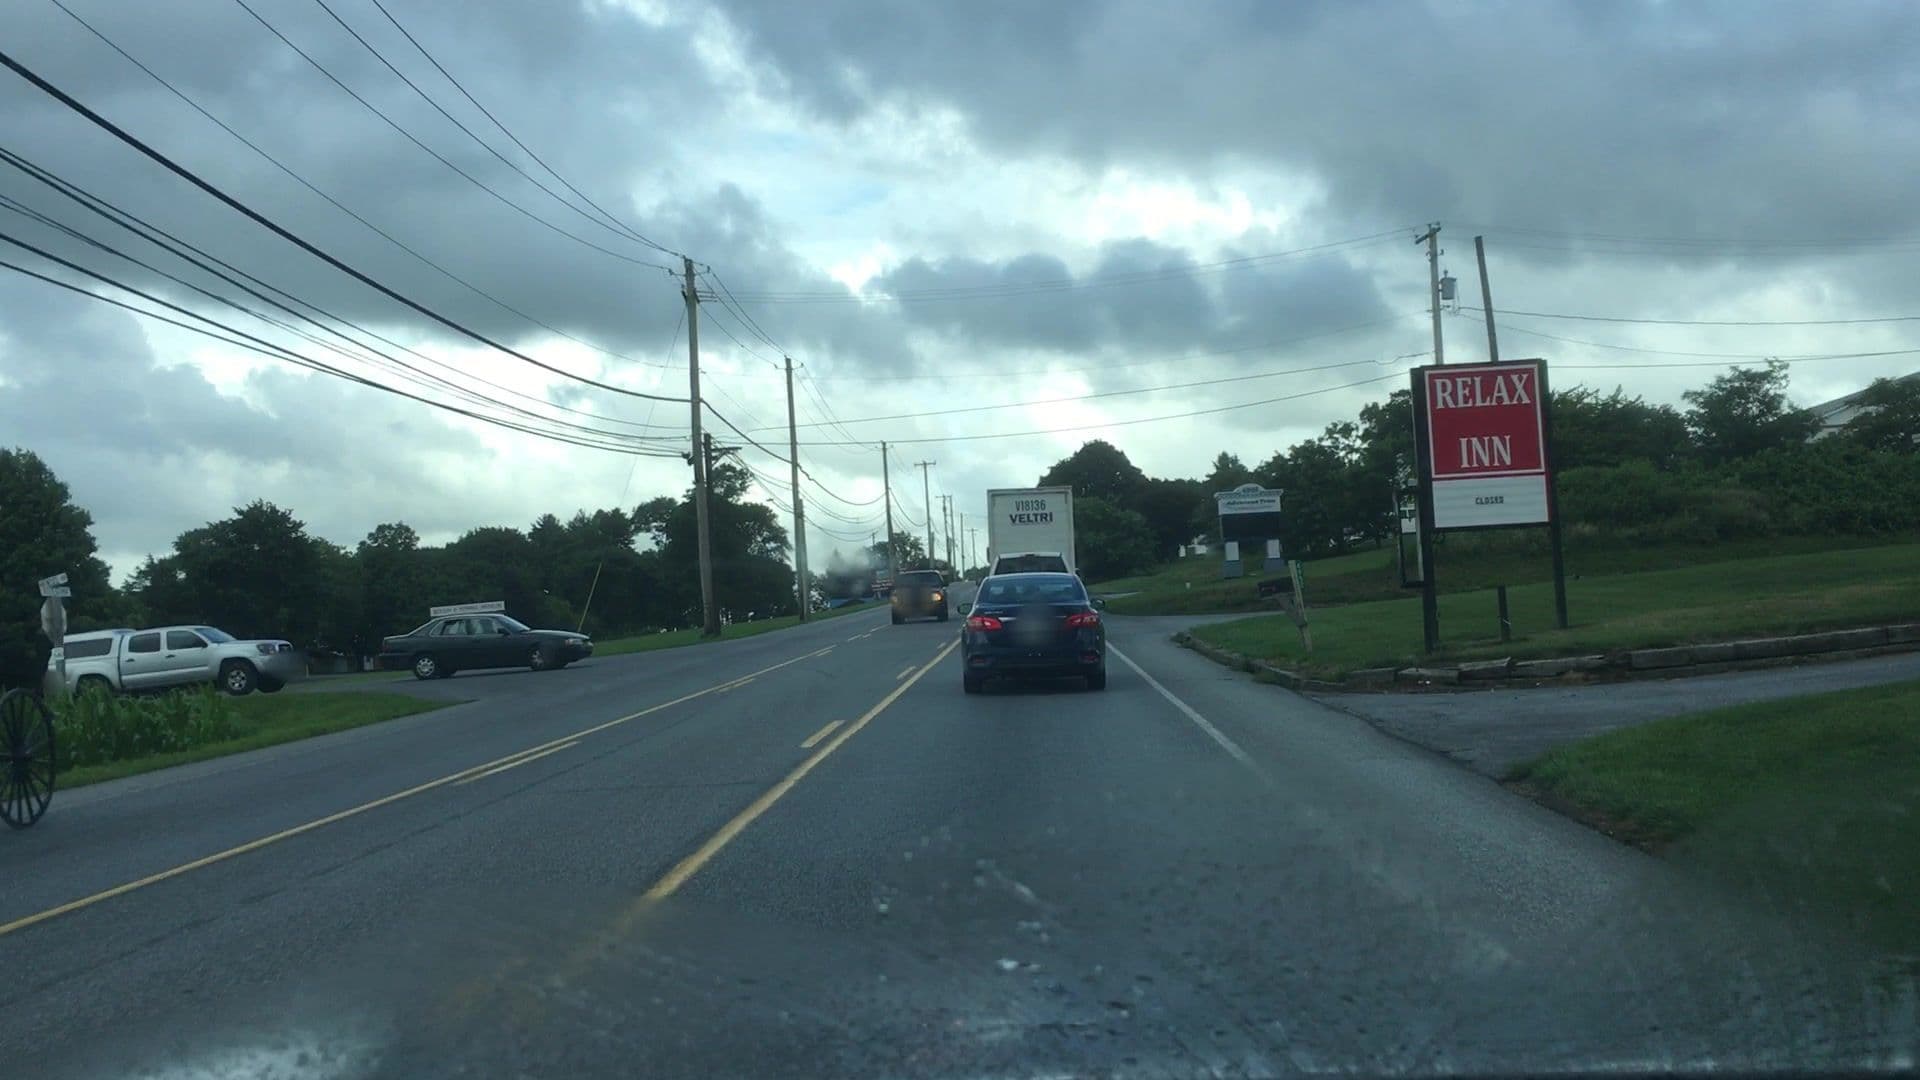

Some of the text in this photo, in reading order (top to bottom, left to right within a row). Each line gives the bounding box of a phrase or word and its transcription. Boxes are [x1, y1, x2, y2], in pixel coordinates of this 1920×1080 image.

[1434, 373, 1531, 409] RELAX
[1459, 435, 1512, 468] INN
[1015, 500, 1046, 512] V18136
[1009, 512, 1053, 524] VELTRI
